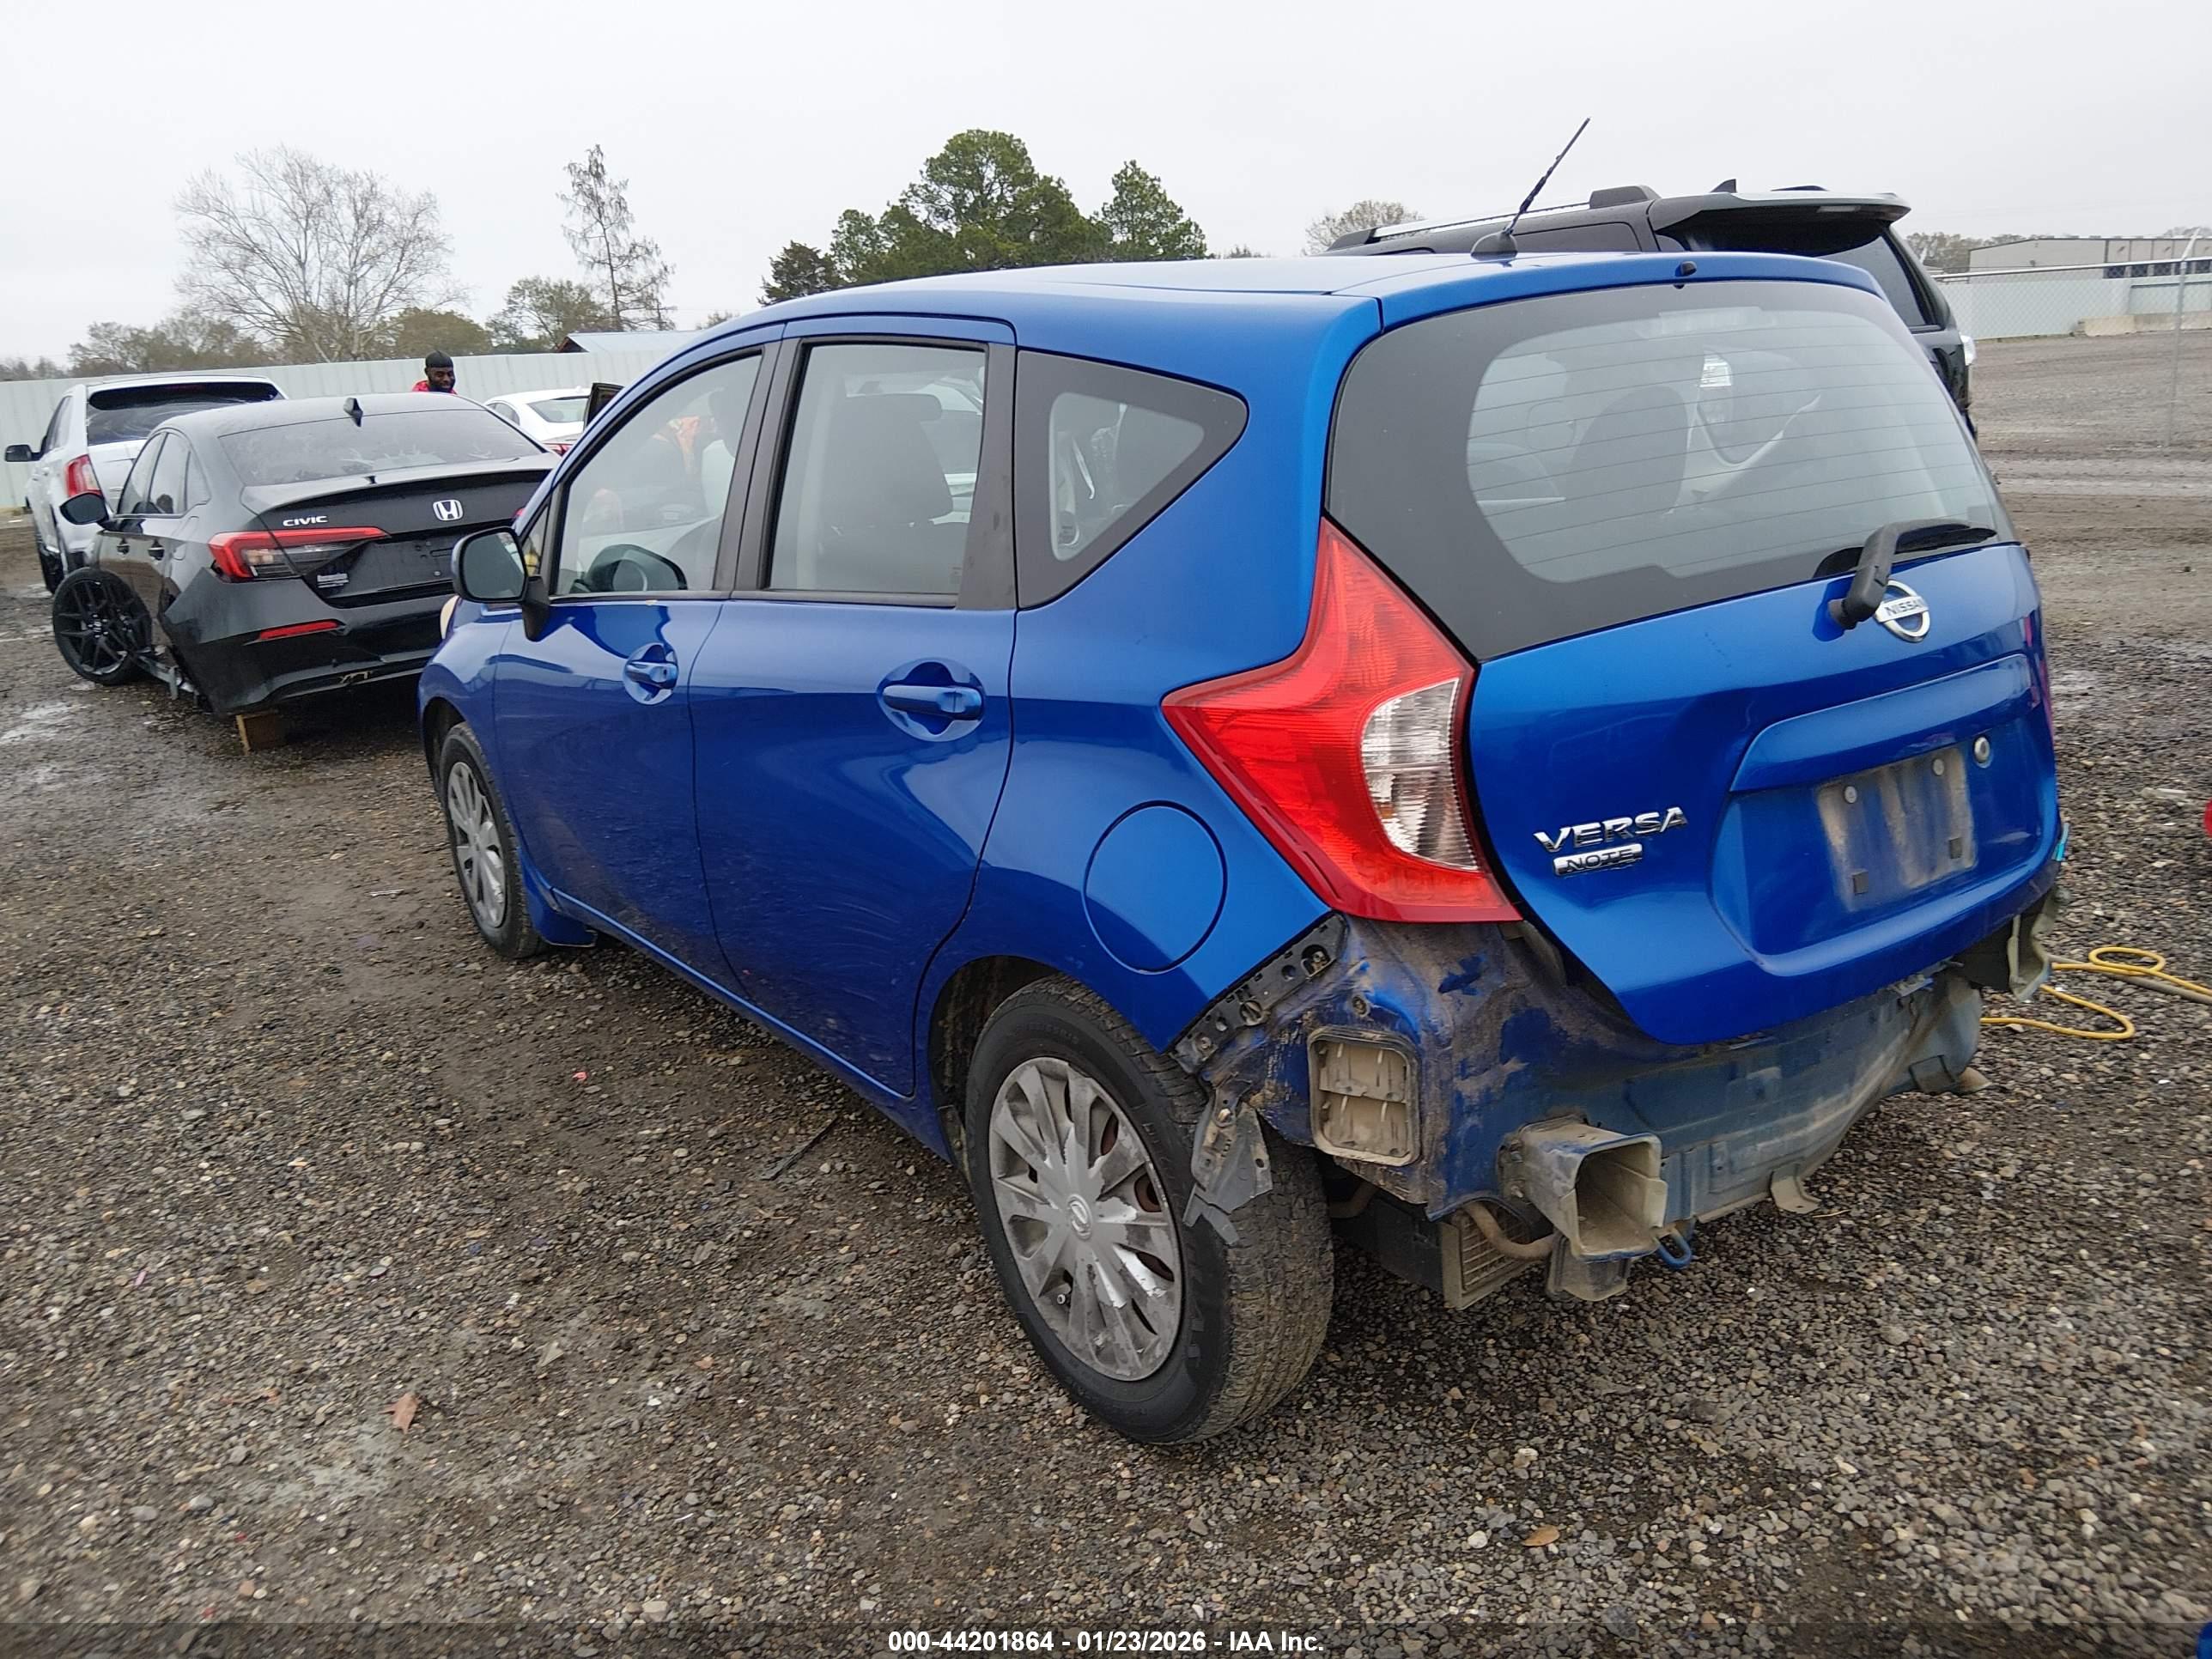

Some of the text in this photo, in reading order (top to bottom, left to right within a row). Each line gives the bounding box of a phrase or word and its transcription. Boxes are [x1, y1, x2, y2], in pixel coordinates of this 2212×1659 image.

[283, 515, 328, 527] CIVIC
[1884, 599, 1926, 617] NISSAN
[1533, 806, 1688, 852] VERSA
[1565, 848, 1637, 872] NOTE
